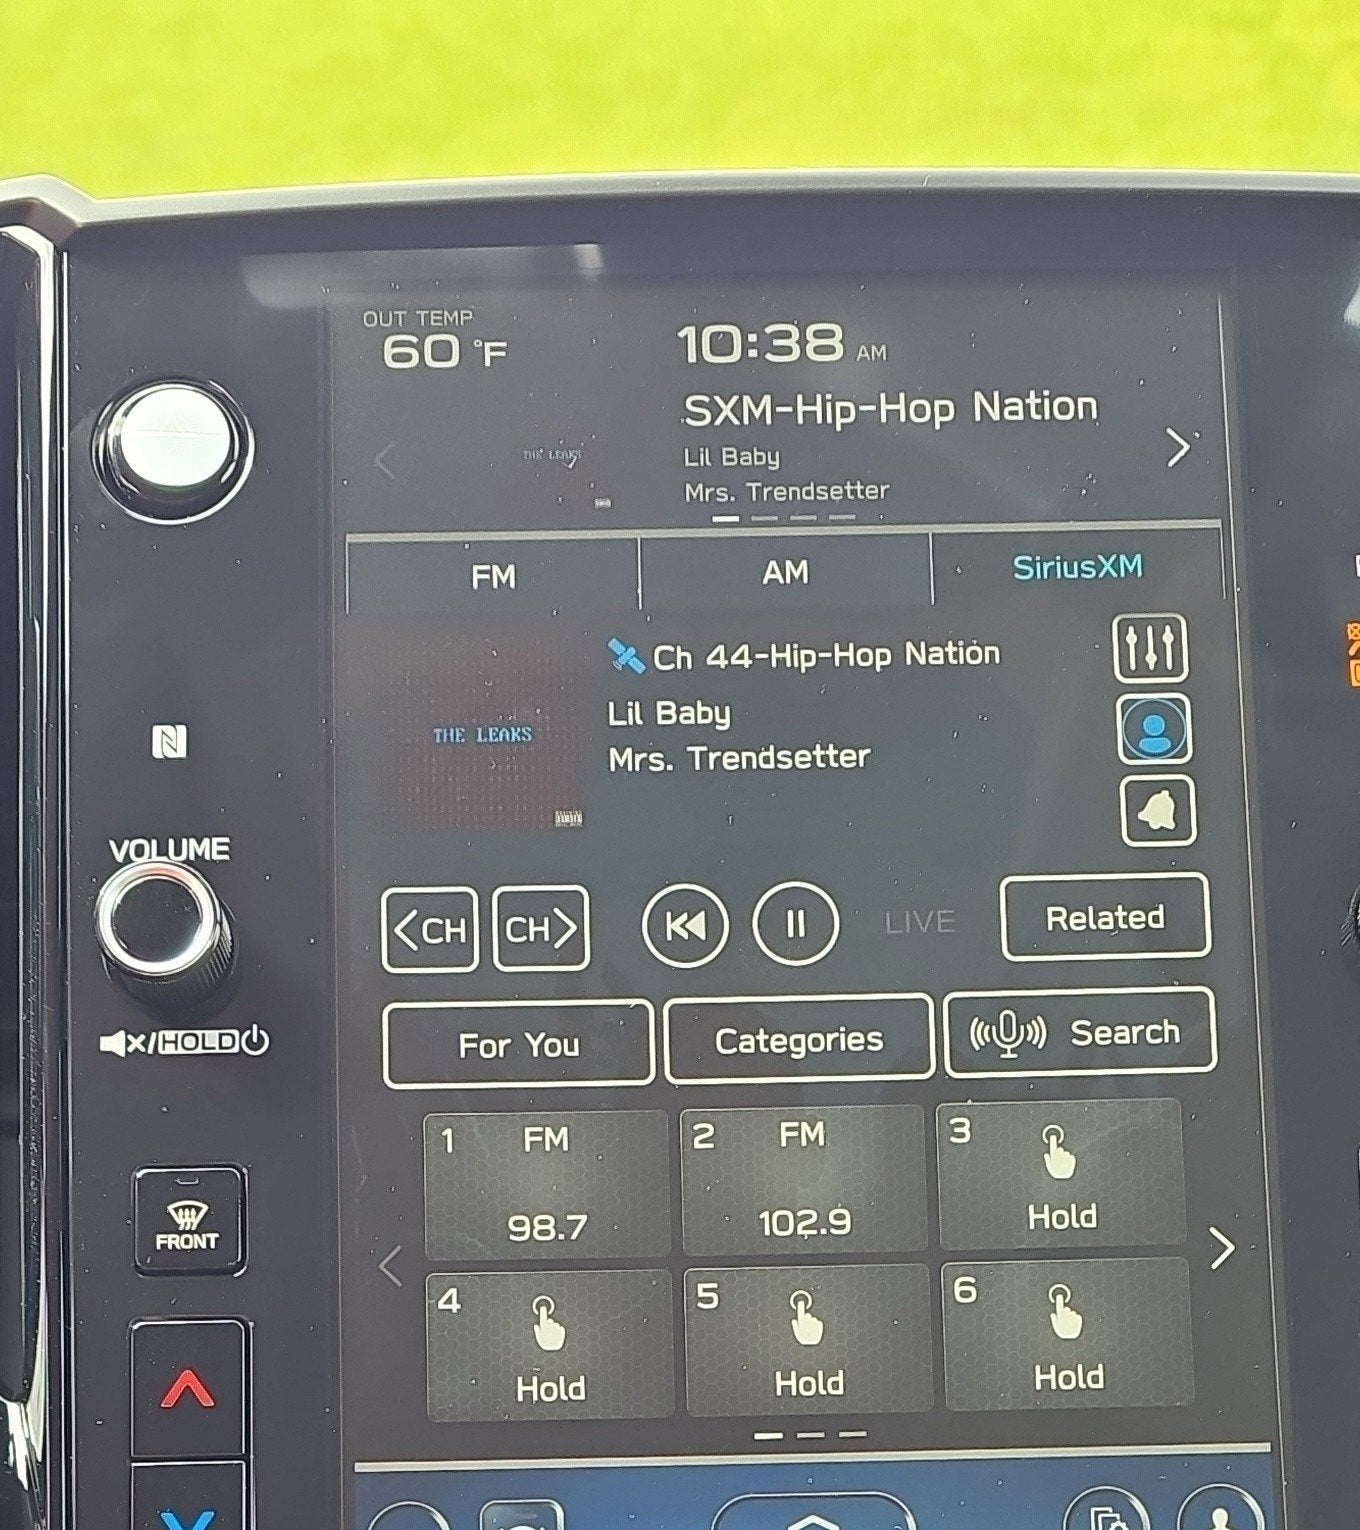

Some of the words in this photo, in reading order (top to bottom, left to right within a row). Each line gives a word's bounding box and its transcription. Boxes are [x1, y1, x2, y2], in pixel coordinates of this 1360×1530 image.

[362, 310, 411, 327] OUT
[418, 309, 474, 326] TEMP
[383, 333, 461, 370] 60
[678, 322, 844, 365] 10:38
[857, 345, 887, 361] AM
[684, 392, 956, 431] SXM-Hip-Hop
[974, 390, 1099, 423] Nation
[684, 447, 713, 468] Lil
[722, 446, 781, 471] Baby
[685, 481, 735, 502] Mrs.
[746, 479, 890, 501] Trendsetter
[472, 563, 516, 590] FM
[762, 559, 810, 586] AM
[1013, 554, 1144, 581] SiriusXM
[653, 643, 694, 671] Ch
[705, 641, 893, 674] 44-Hip-Hop
[905, 639, 1001, 668] Nation
[608, 701, 643, 726] Lil
[655, 699, 731, 730] Baby
[433, 728, 465, 743] THE
[476, 727, 532, 742] LEAKS
[609, 746, 673, 773] Mrs.
[686, 742, 872, 771] Trendsetter
[109, 837, 231, 863] VOLUME
[422, 918, 467, 943] CH
[506, 917, 551, 943] CH
[885, 908, 956, 935] LIVE
[1046, 904, 1166, 934] Related
[459, 1033, 510, 1060] For
[526, 1031, 580, 1058] You
[715, 1025, 884, 1060] Categories
[1070, 1018, 1181, 1047] Search
[441, 1129, 455, 1154] 1
[523, 1127, 570, 1153] FM
[692, 1124, 715, 1149] 2
[779, 1121, 826, 1148] FM
[949, 1117, 972, 1144] 3
[507, 1213, 588, 1243] 98.7
[759, 1208, 853, 1238] 102.9
[1027, 1202, 1098, 1232] Hold
[156, 1234, 219, 1249] FRONT
[437, 1288, 462, 1314] 4
[697, 1284, 720, 1310] 5
[953, 1277, 977, 1304] 6
[516, 1374, 587, 1403] Hold
[774, 1370, 845, 1398] Hold
[1034, 1363, 1105, 1392] Hold
